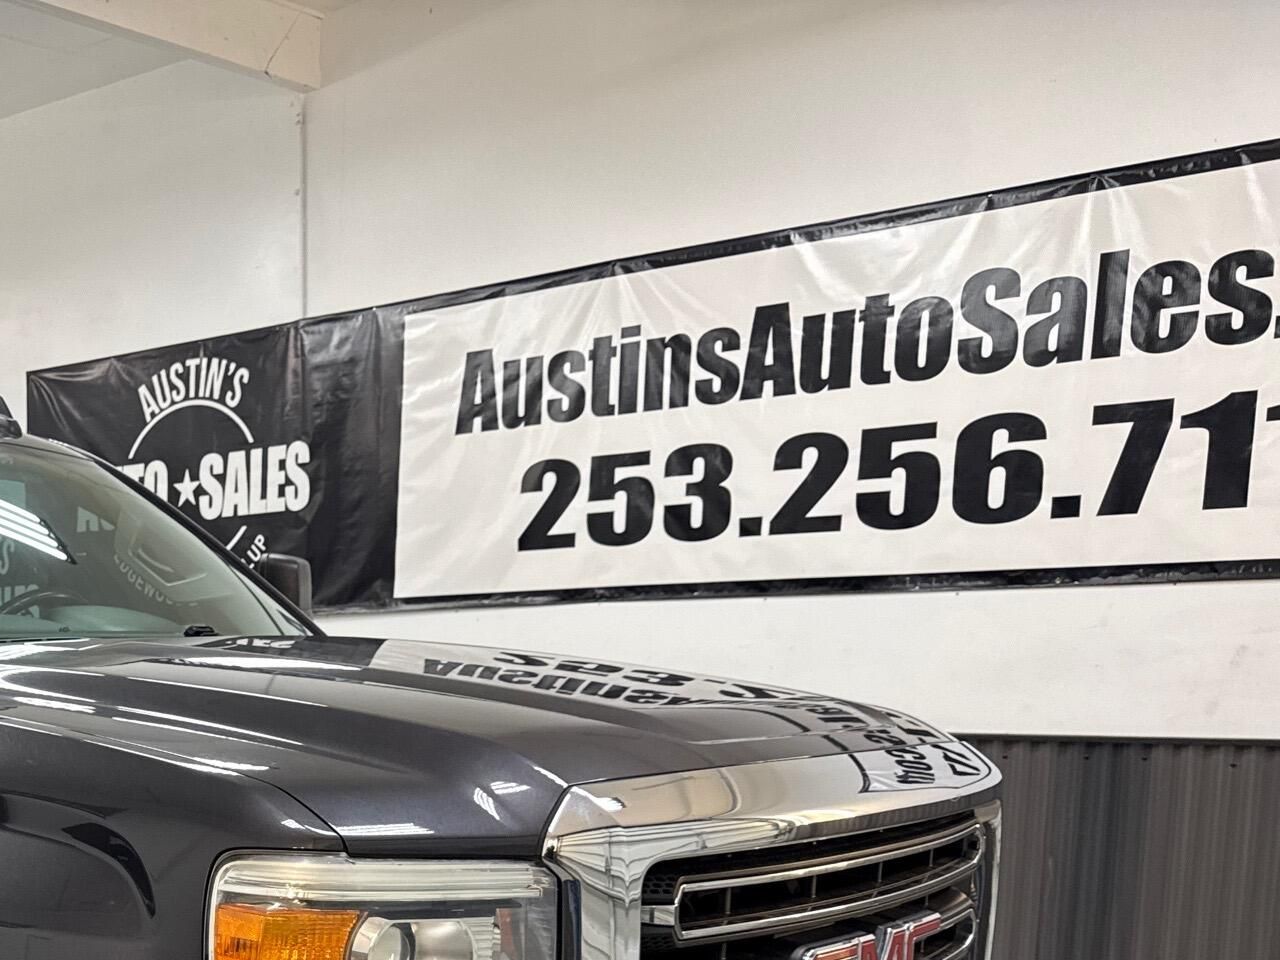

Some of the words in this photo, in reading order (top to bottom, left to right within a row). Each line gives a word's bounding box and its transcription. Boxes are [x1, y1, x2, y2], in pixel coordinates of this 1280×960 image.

[137, 356, 250, 422] AUSTIN'S
[454, 248, 1280, 436] AustinsAutoSales
[198, 440, 311, 521] SALES
[517, 389, 1280, 552] 253.256.71
